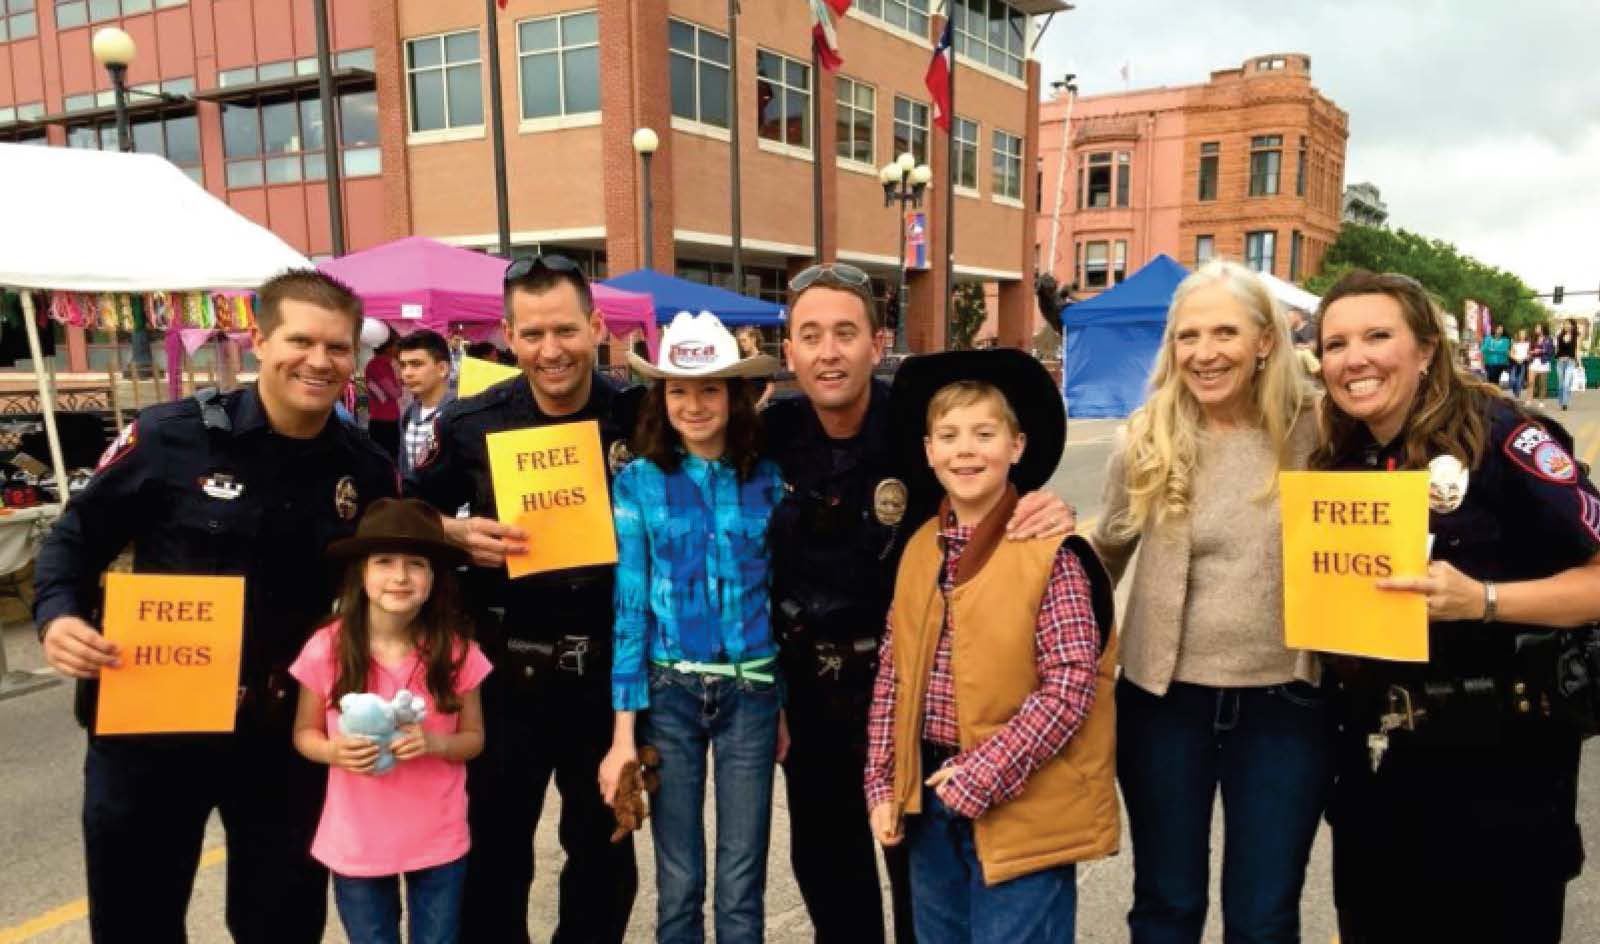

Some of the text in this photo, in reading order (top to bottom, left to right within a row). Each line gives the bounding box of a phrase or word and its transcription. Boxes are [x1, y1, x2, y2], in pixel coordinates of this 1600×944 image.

[516, 446, 580, 472] FREE
[521, 486, 587, 512] HUGS
[1312, 500, 1391, 525] FREE
[1312, 551, 1392, 577] HUGS
[138, 600, 214, 622] FREE
[134, 645, 212, 666] HUGS
